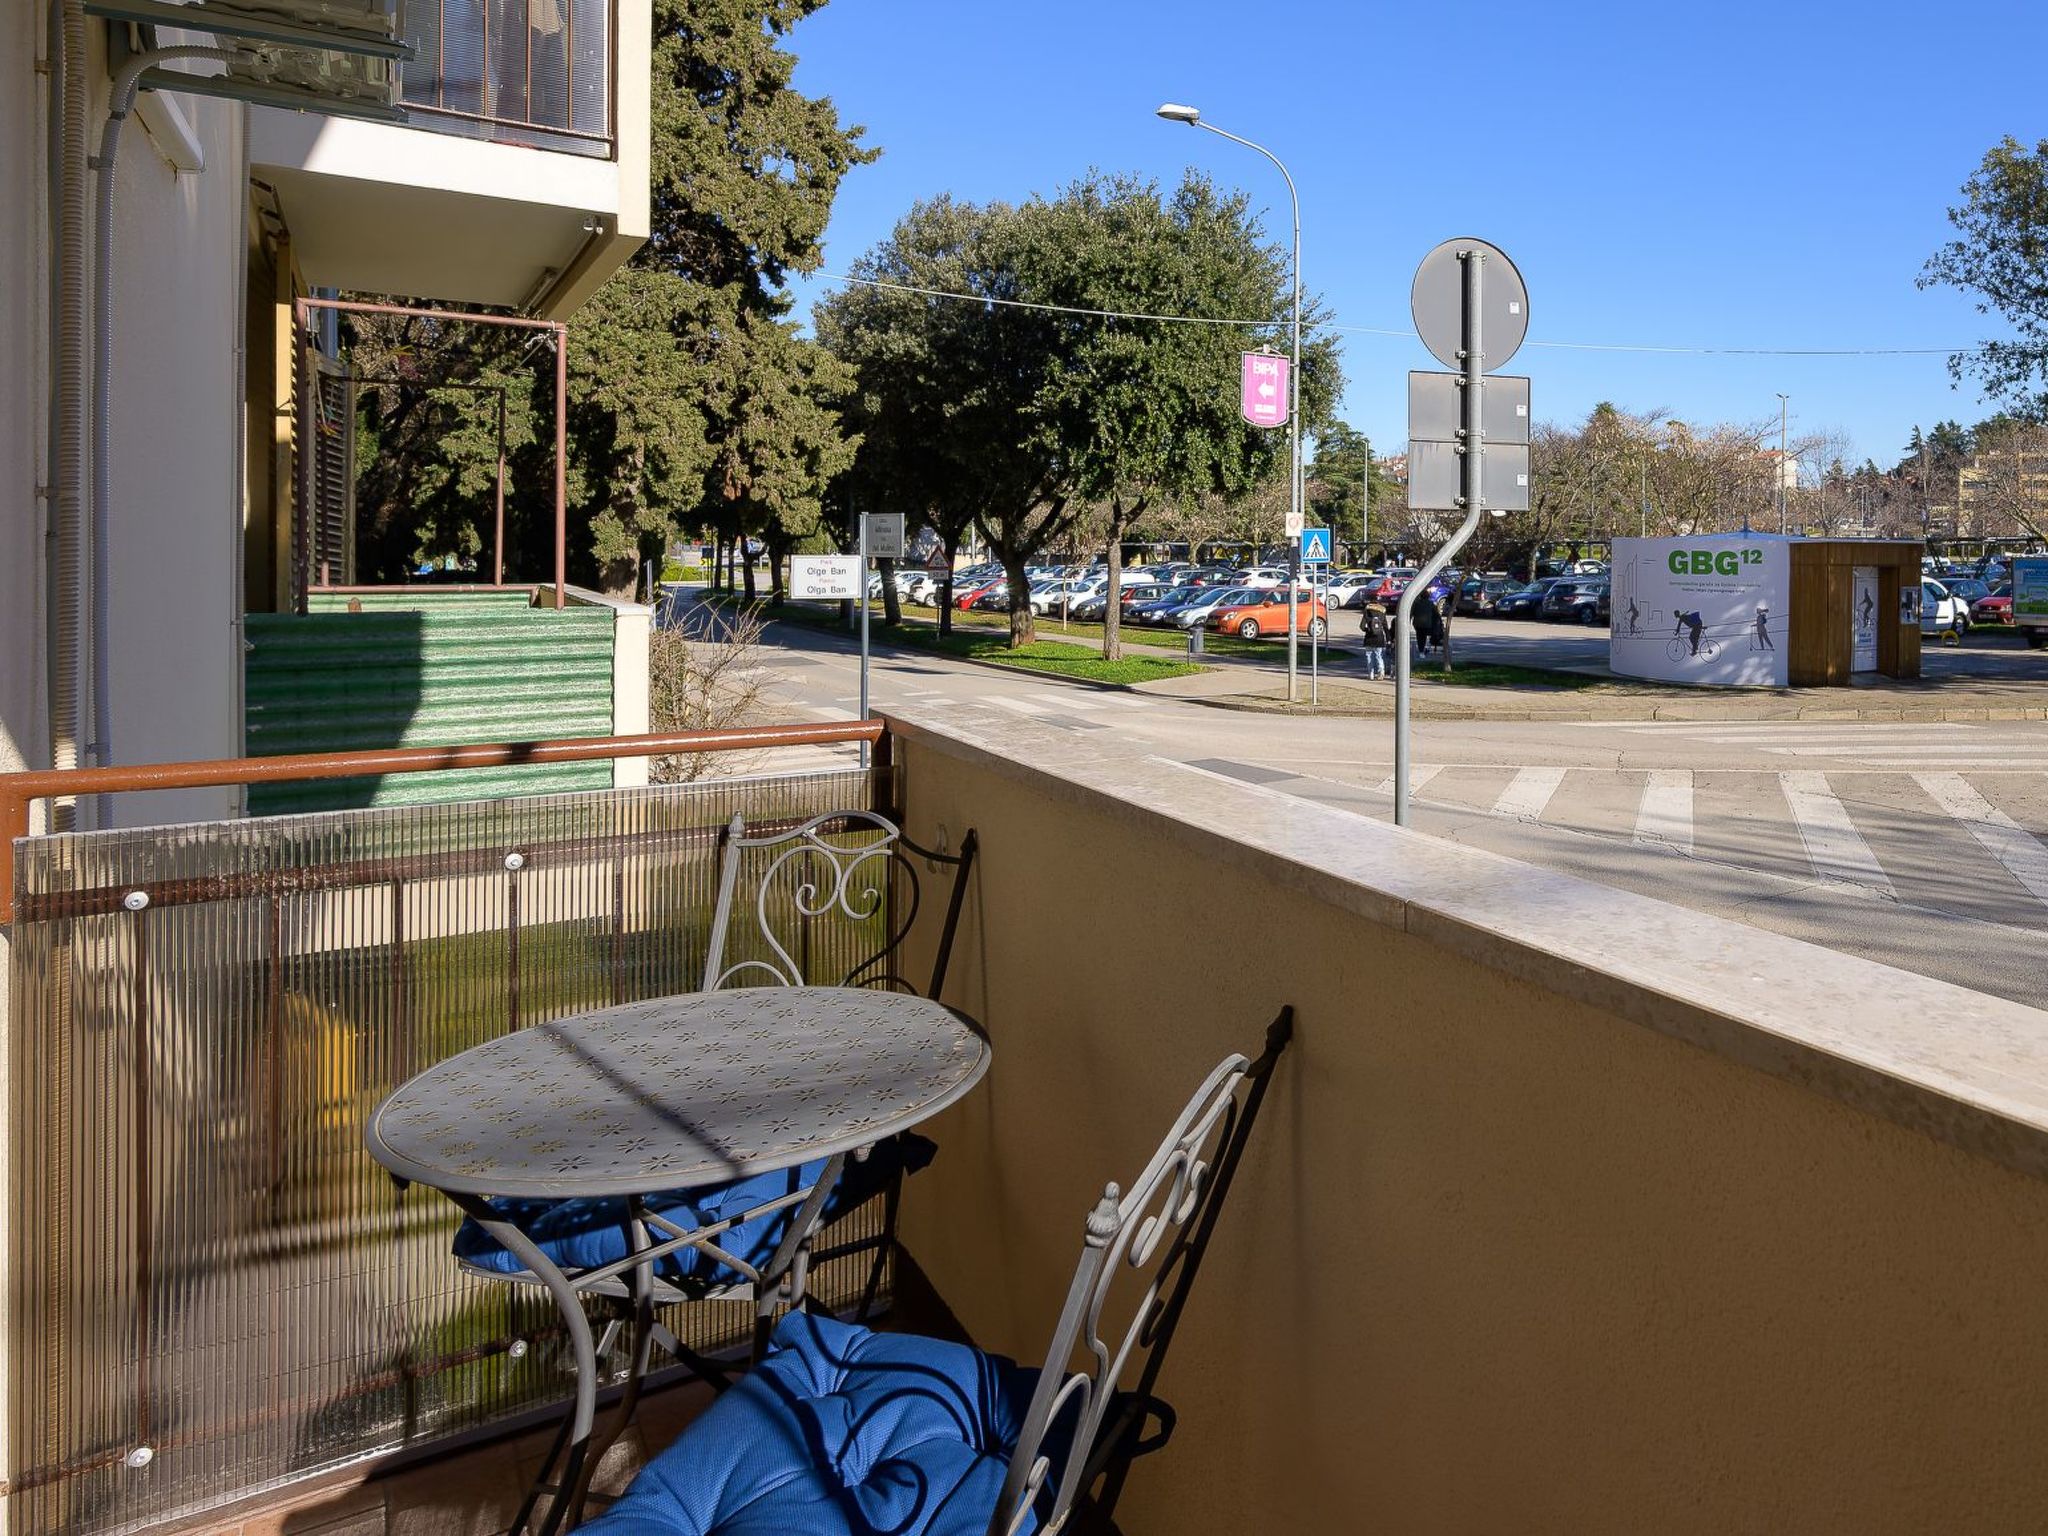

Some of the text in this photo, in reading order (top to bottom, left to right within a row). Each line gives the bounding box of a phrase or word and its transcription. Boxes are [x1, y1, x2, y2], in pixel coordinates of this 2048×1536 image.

[1253, 361, 1279, 376] BIPA
[830, 567, 847, 575] Ban
[806, 585, 847, 595] Olga Ban
